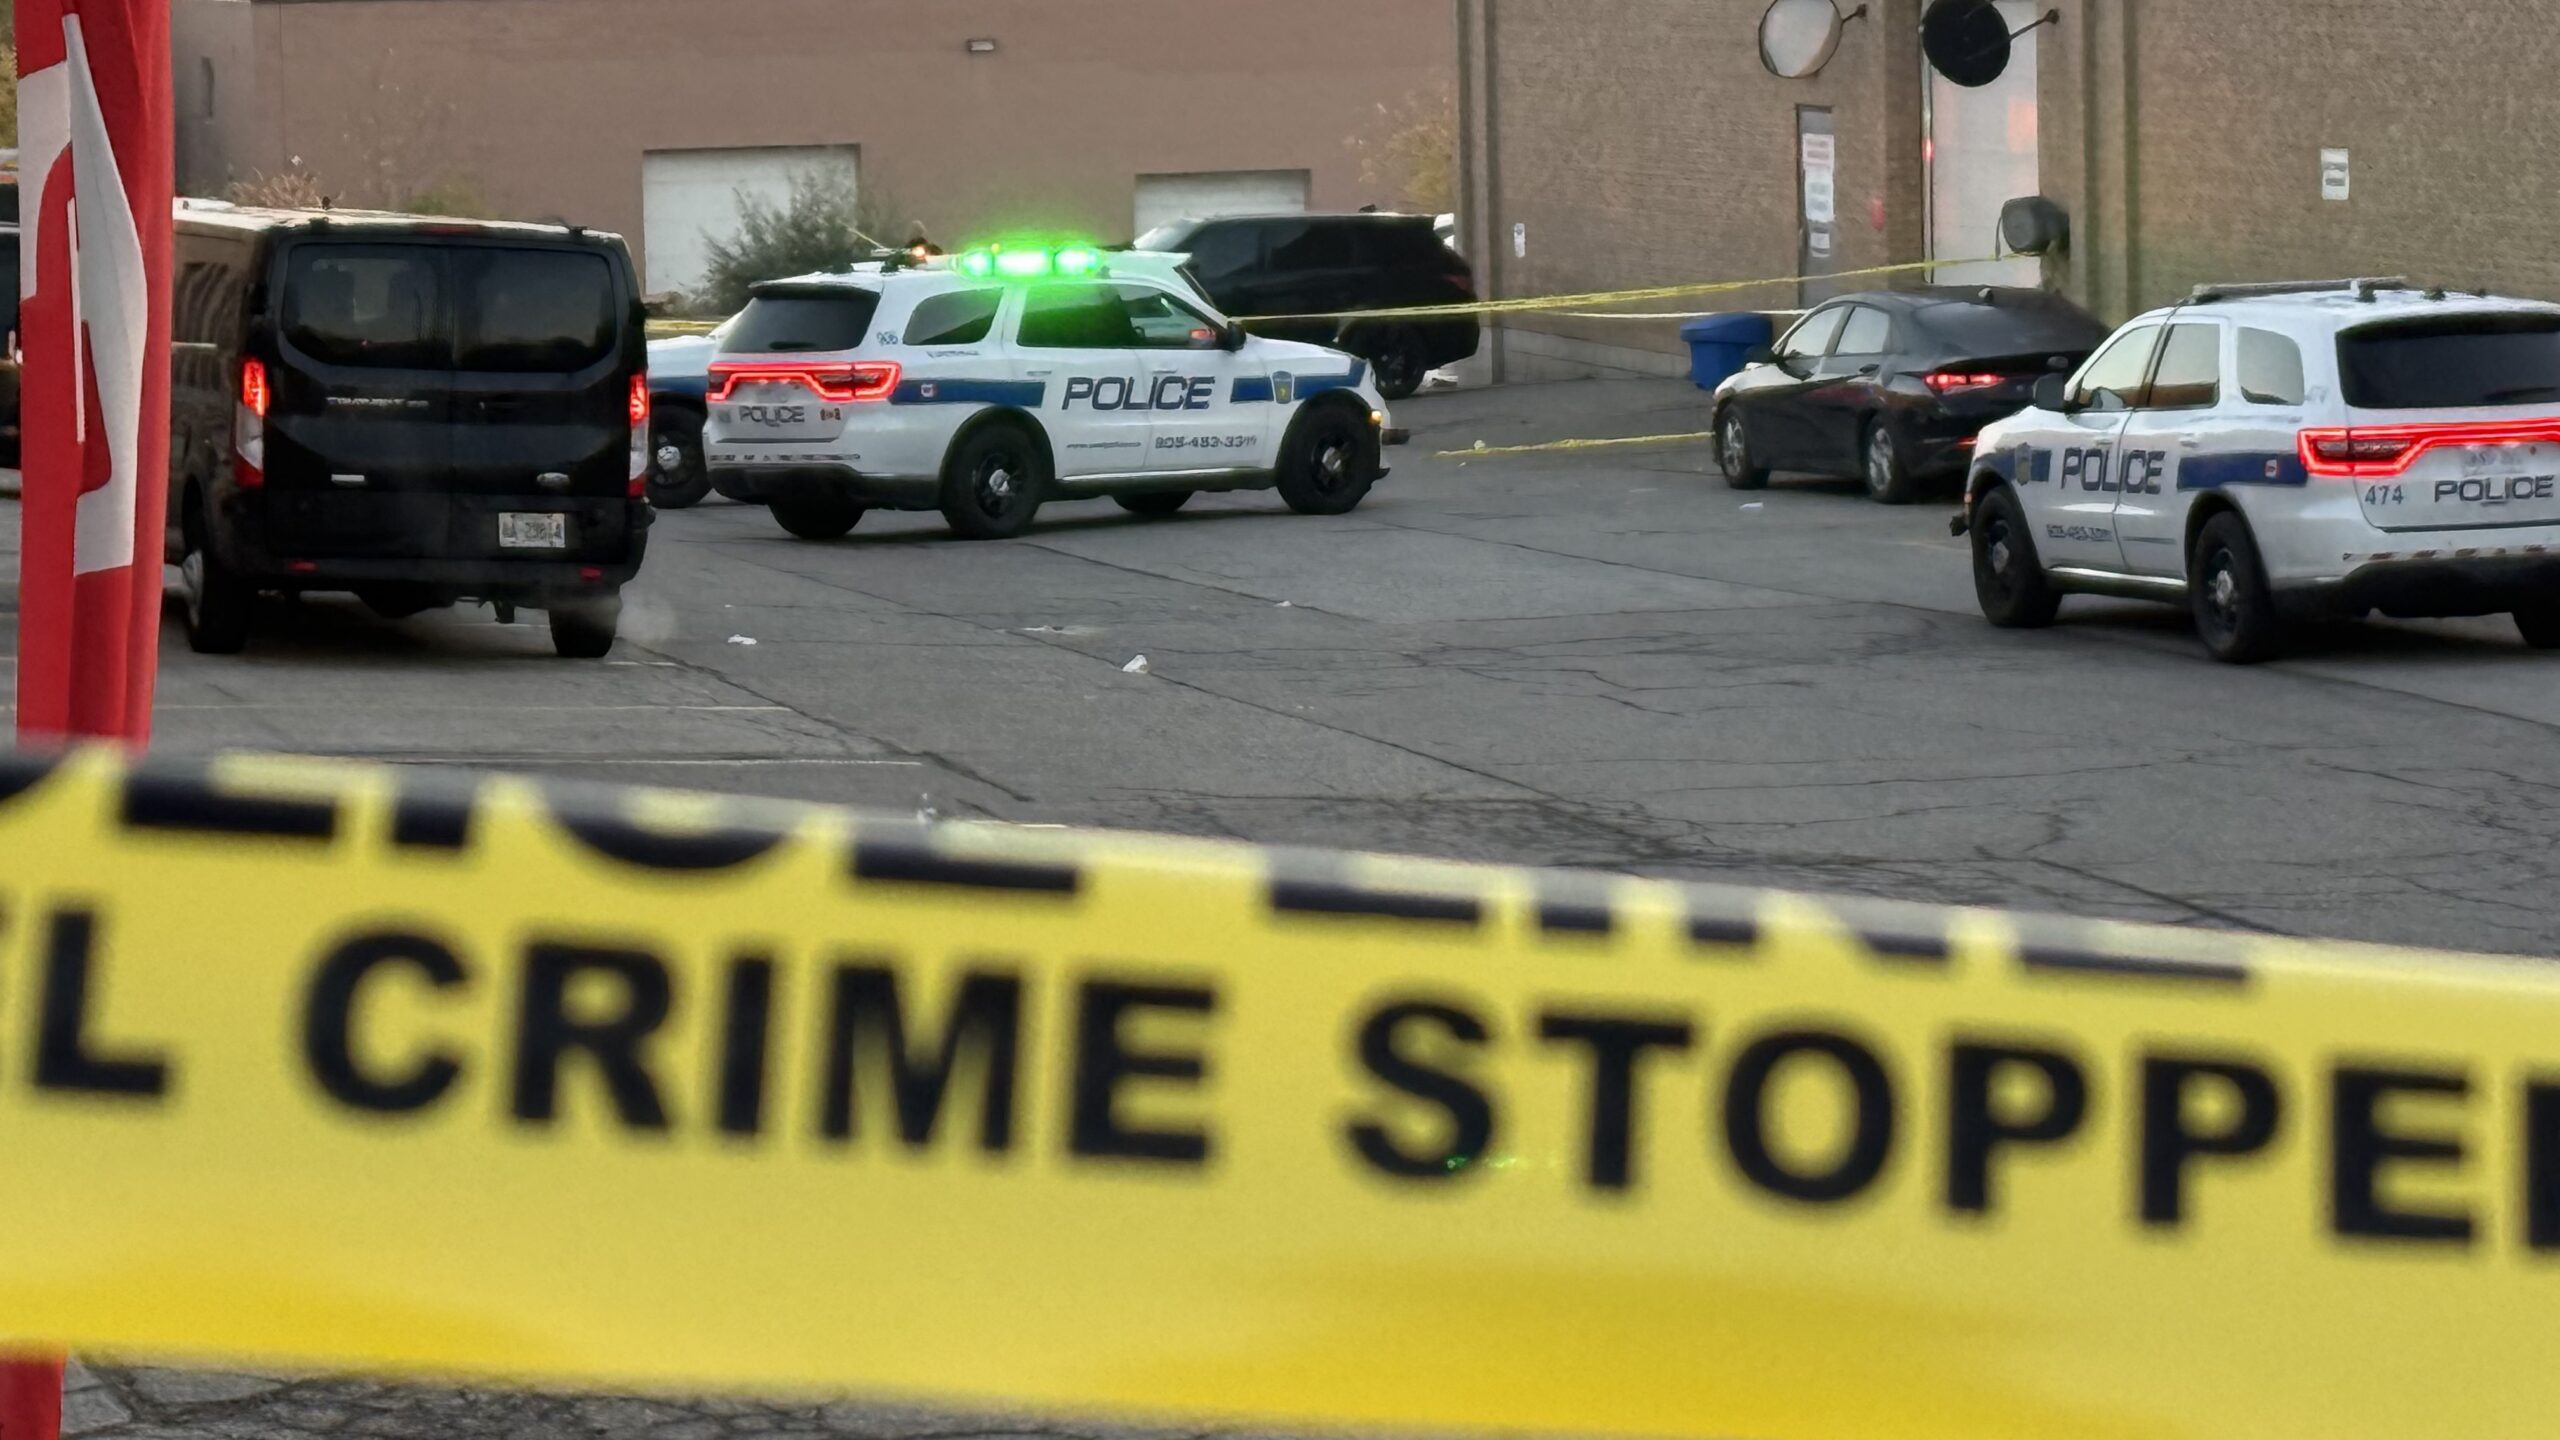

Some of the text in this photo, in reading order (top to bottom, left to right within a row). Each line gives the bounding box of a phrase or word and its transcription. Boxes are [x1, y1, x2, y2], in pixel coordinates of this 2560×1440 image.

[1061, 376, 1216, 411] POLICE
[738, 405, 805, 424] POLICE
[2061, 447, 2166, 495] POLICE
[2364, 483, 2405, 506] 474
[2433, 474, 2556, 503] POLICE
[294, 922, 1221, 1170] CRIME
